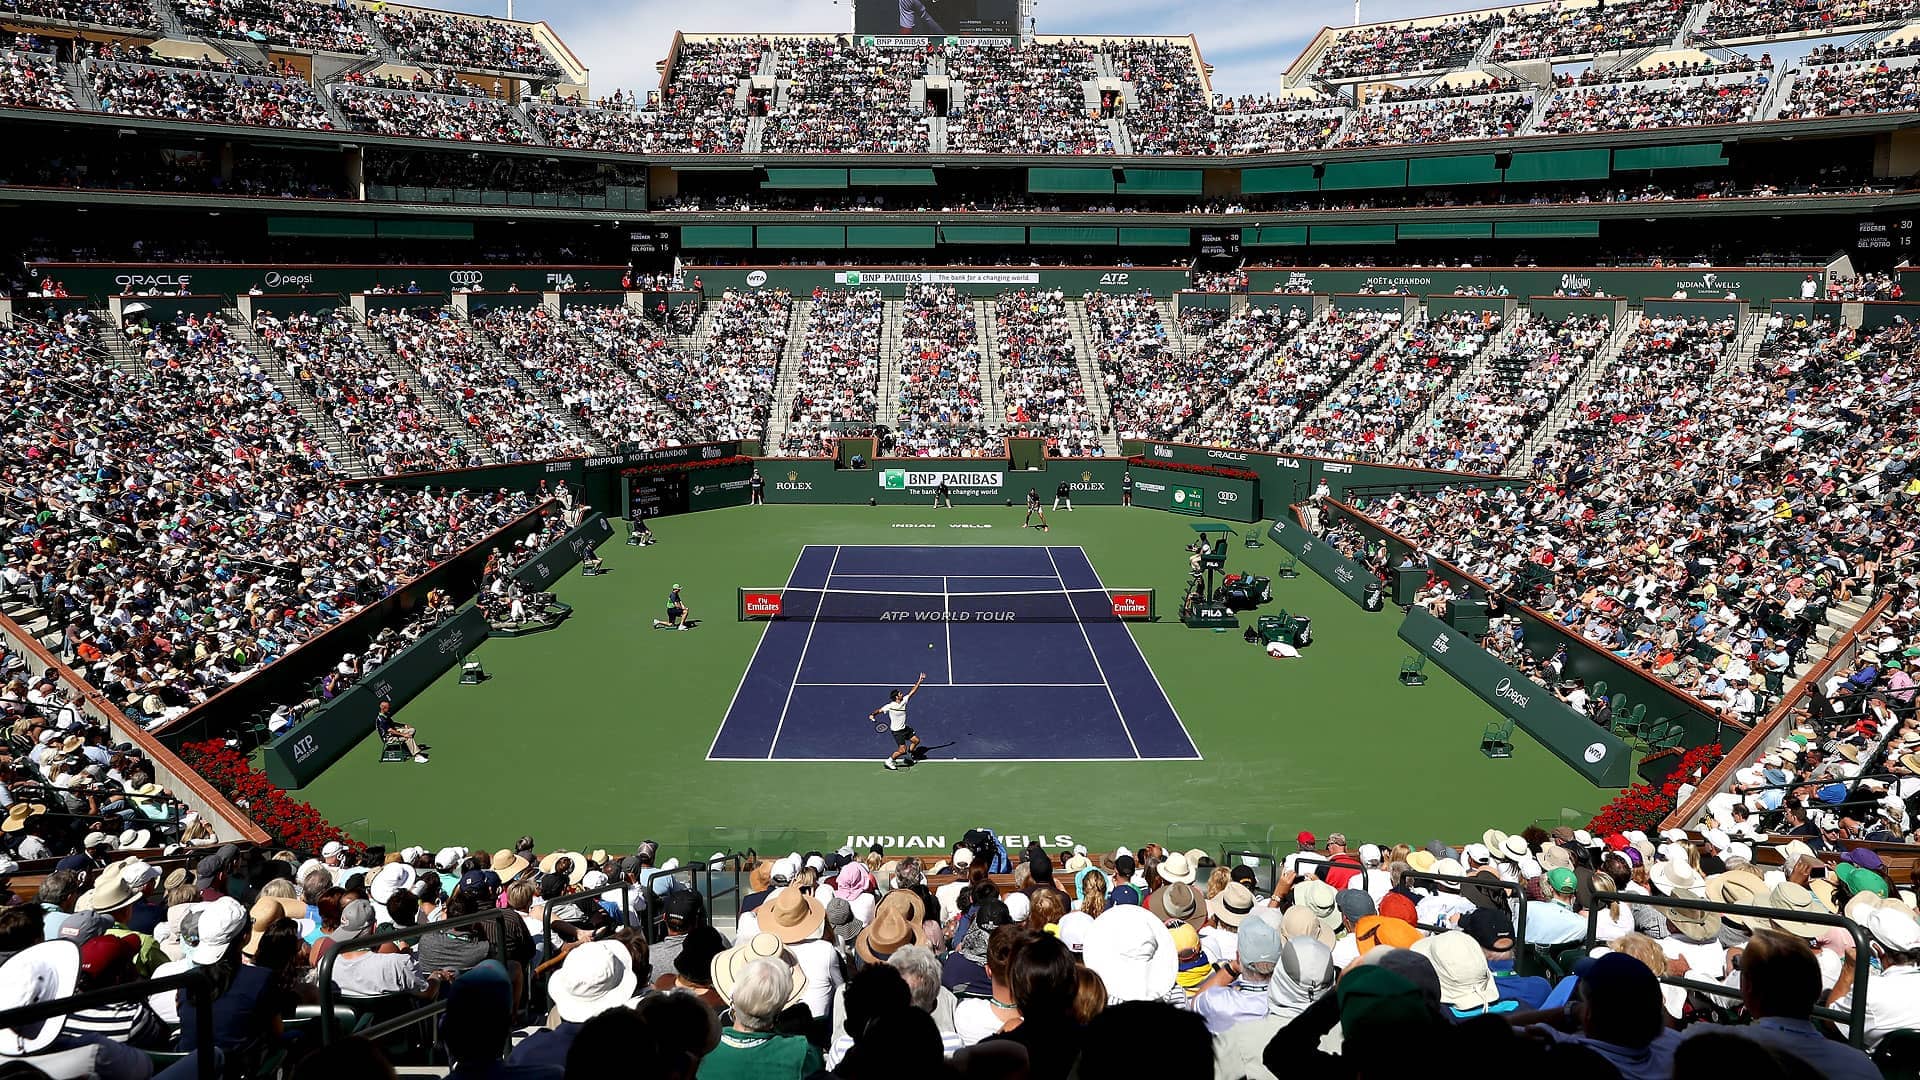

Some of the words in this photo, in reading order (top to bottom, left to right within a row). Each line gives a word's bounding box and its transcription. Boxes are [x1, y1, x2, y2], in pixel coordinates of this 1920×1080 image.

[1900, 220, 1913, 229] 30
[1900, 236, 1911, 246] 15
[661, 243, 669, 251] 15
[1231, 245, 1239, 253] 15
[115, 275, 190, 286] ORACLE
[282, 274, 313, 285] pepsi
[546, 273, 574, 285] FILA
[862, 274, 881, 282] BNP
[884, 274, 923, 282] PARIBAS
[966, 274, 975, 282] for
[983, 274, 1009, 283] changing
[1100, 273, 1129, 282] ATP
[1393, 277, 1431, 285] CHANDON
[1676, 281, 1705, 289] INDIAN
[1714, 281, 1741, 289] WELLS
[654, 448, 688, 459] CHANDON
[1207, 450, 1247, 461] ORACLE
[1276, 457, 1300, 469] FILA
[1323, 462, 1353, 474] ESPN
[909, 473, 936, 485] BNP
[942, 473, 998, 485] PARIBAS
[776, 482, 812, 490] ROLEX
[1069, 482, 1105, 490] ROLEX
[952, 488, 980, 497] changing
[649, 506, 659, 516] 15
[757, 597, 769, 605] Fly
[747, 603, 779, 611] Emirates
[1114, 603, 1146, 612] Emirates
[879, 611, 910, 621] ATP
[914, 611, 970, 621] WORLD
[974, 611, 1016, 621] TOUR
[1201, 608, 1222, 618] FILA
[1505, 688, 1531, 709] pepsi
[293, 734, 313, 760] ATP
[1587, 747, 1602, 759] WTA
[846, 835, 946, 848] INDIAN
